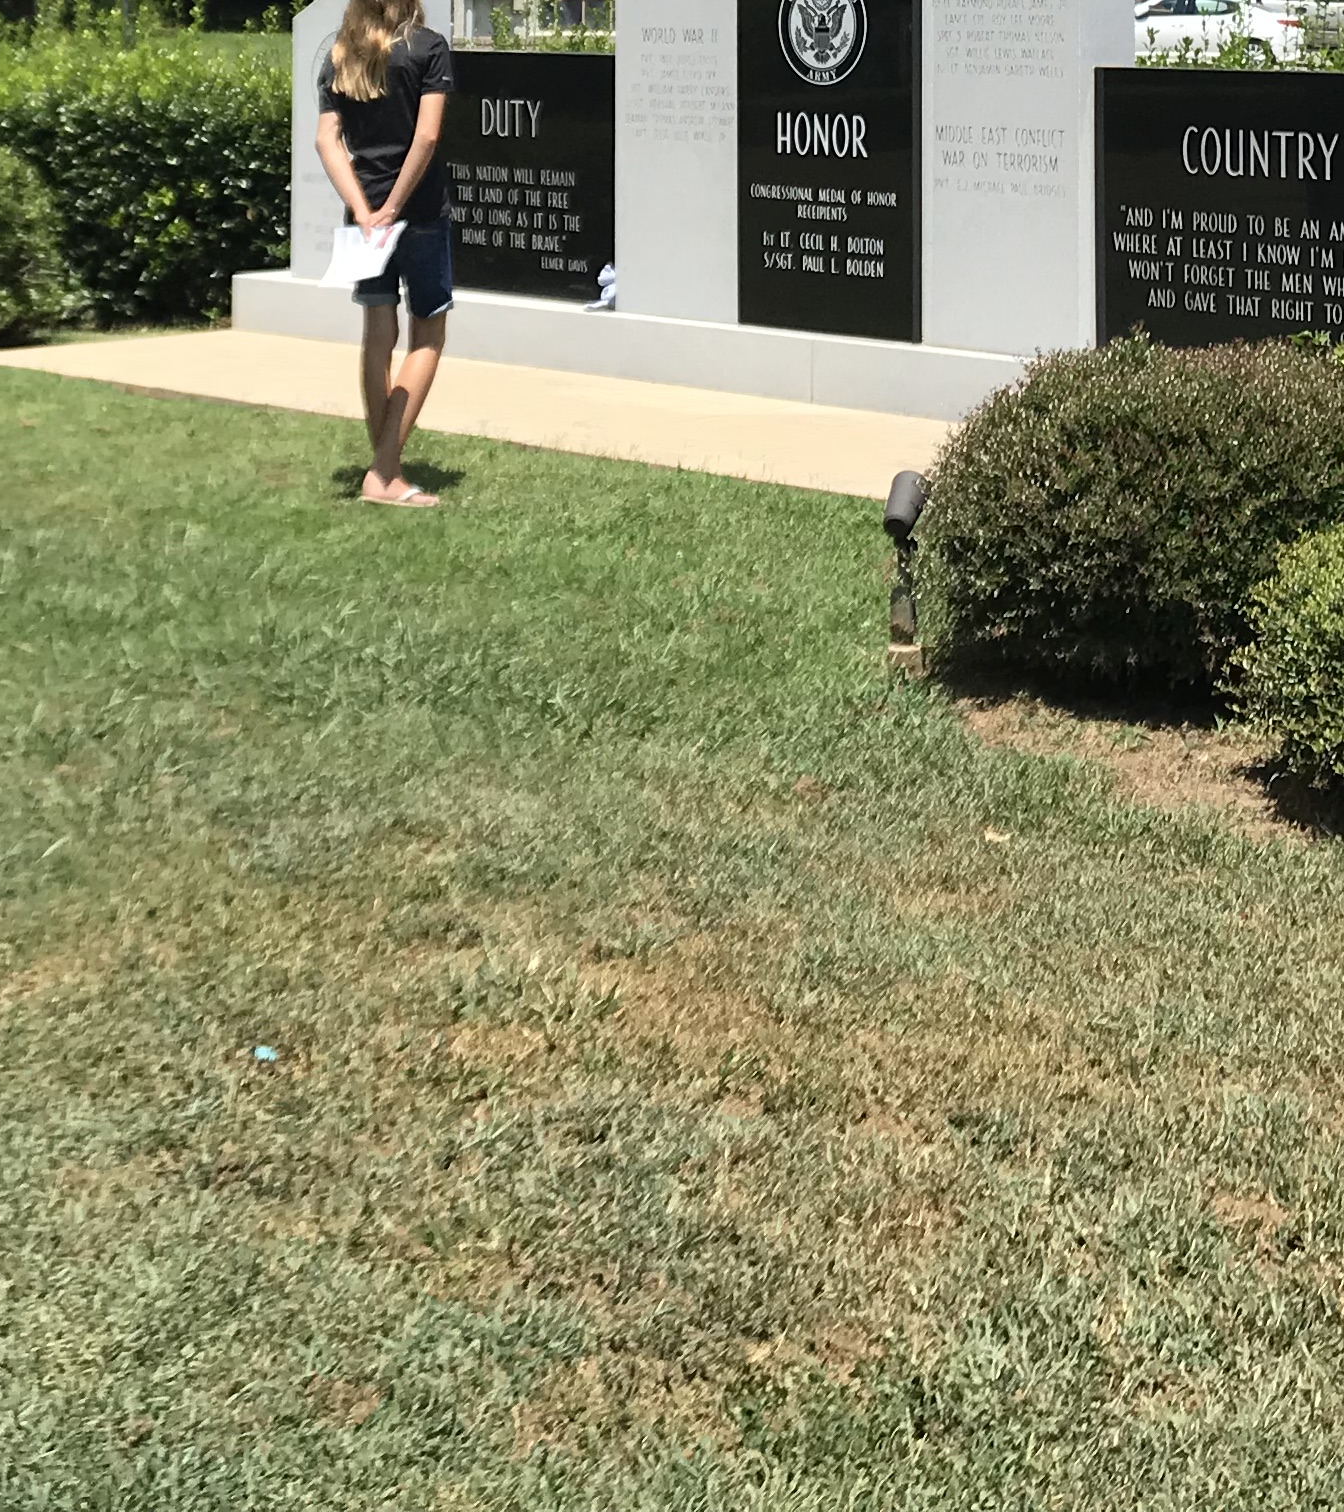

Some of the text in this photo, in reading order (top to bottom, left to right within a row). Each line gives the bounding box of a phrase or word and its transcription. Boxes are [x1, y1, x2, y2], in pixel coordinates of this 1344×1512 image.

[641, 27, 718, 44] WORLD WAR II
[806, 68, 837, 82] ARMY
[481, 98, 541, 138] DUTY
[776, 111, 869, 158] HONOR
[935, 125, 1065, 149] MIDDLE EAST CONFLICT
[942, 150, 1059, 174] WAR ON TERRORISM
[1181, 124, 1339, 181] COUNTRY
[475, 165, 508, 183] NATION
[513, 168, 534, 185] WILL
[540, 168, 576, 187] REMAIN
[456, 184, 569, 210] THE LAND OF THE FREE
[750, 183, 897, 207] CONGRESSIONAL MEDAL OF HONOR
[449, 206, 581, 232] NLY SO LONG AS IT IS THE
[797, 204, 848, 222] RECEIPIENTS
[1120, 204, 1154, 228] "AND
[1162, 208, 1183, 231] I'M
[1192, 211, 1237, 235] PROUD
[1246, 214, 1265, 236] TO
[1274, 217, 1291, 238] BE
[1300, 219, 1320, 240] AN
[462, 228, 487, 246] HOME
[492, 230, 504, 248] OF
[509, 232, 526, 250] THE
[799, 232, 824, 251] CECIL
[830, 235, 841, 252] H.
[847, 236, 884, 256] BOLTON
[1113, 231, 1158, 255] WHERE
[1166, 235, 1183, 257] AT
[1192, 239, 1233, 262] LEAST
[1242, 242, 1247, 262] I
[1257, 243, 1301, 266] KNOW
[1310, 247, 1334, 269] I'M
[540, 256, 564, 271] ELMER
[763, 251, 884, 278] S/SGT. PAUL L. BOLDEN
[1128, 259, 1174, 283] WON'T
[1183, 263, 1236, 287] FORGET
[1244, 268, 1271, 291] THE
[1281, 272, 1313, 295] MEN
[1147, 288, 1176, 309] AND
[1184, 291, 1217, 313] GAVE
[1226, 294, 1262, 318] THAT
[1271, 299, 1314, 322] RIGHT
[1324, 303, 1343, 325] TO
